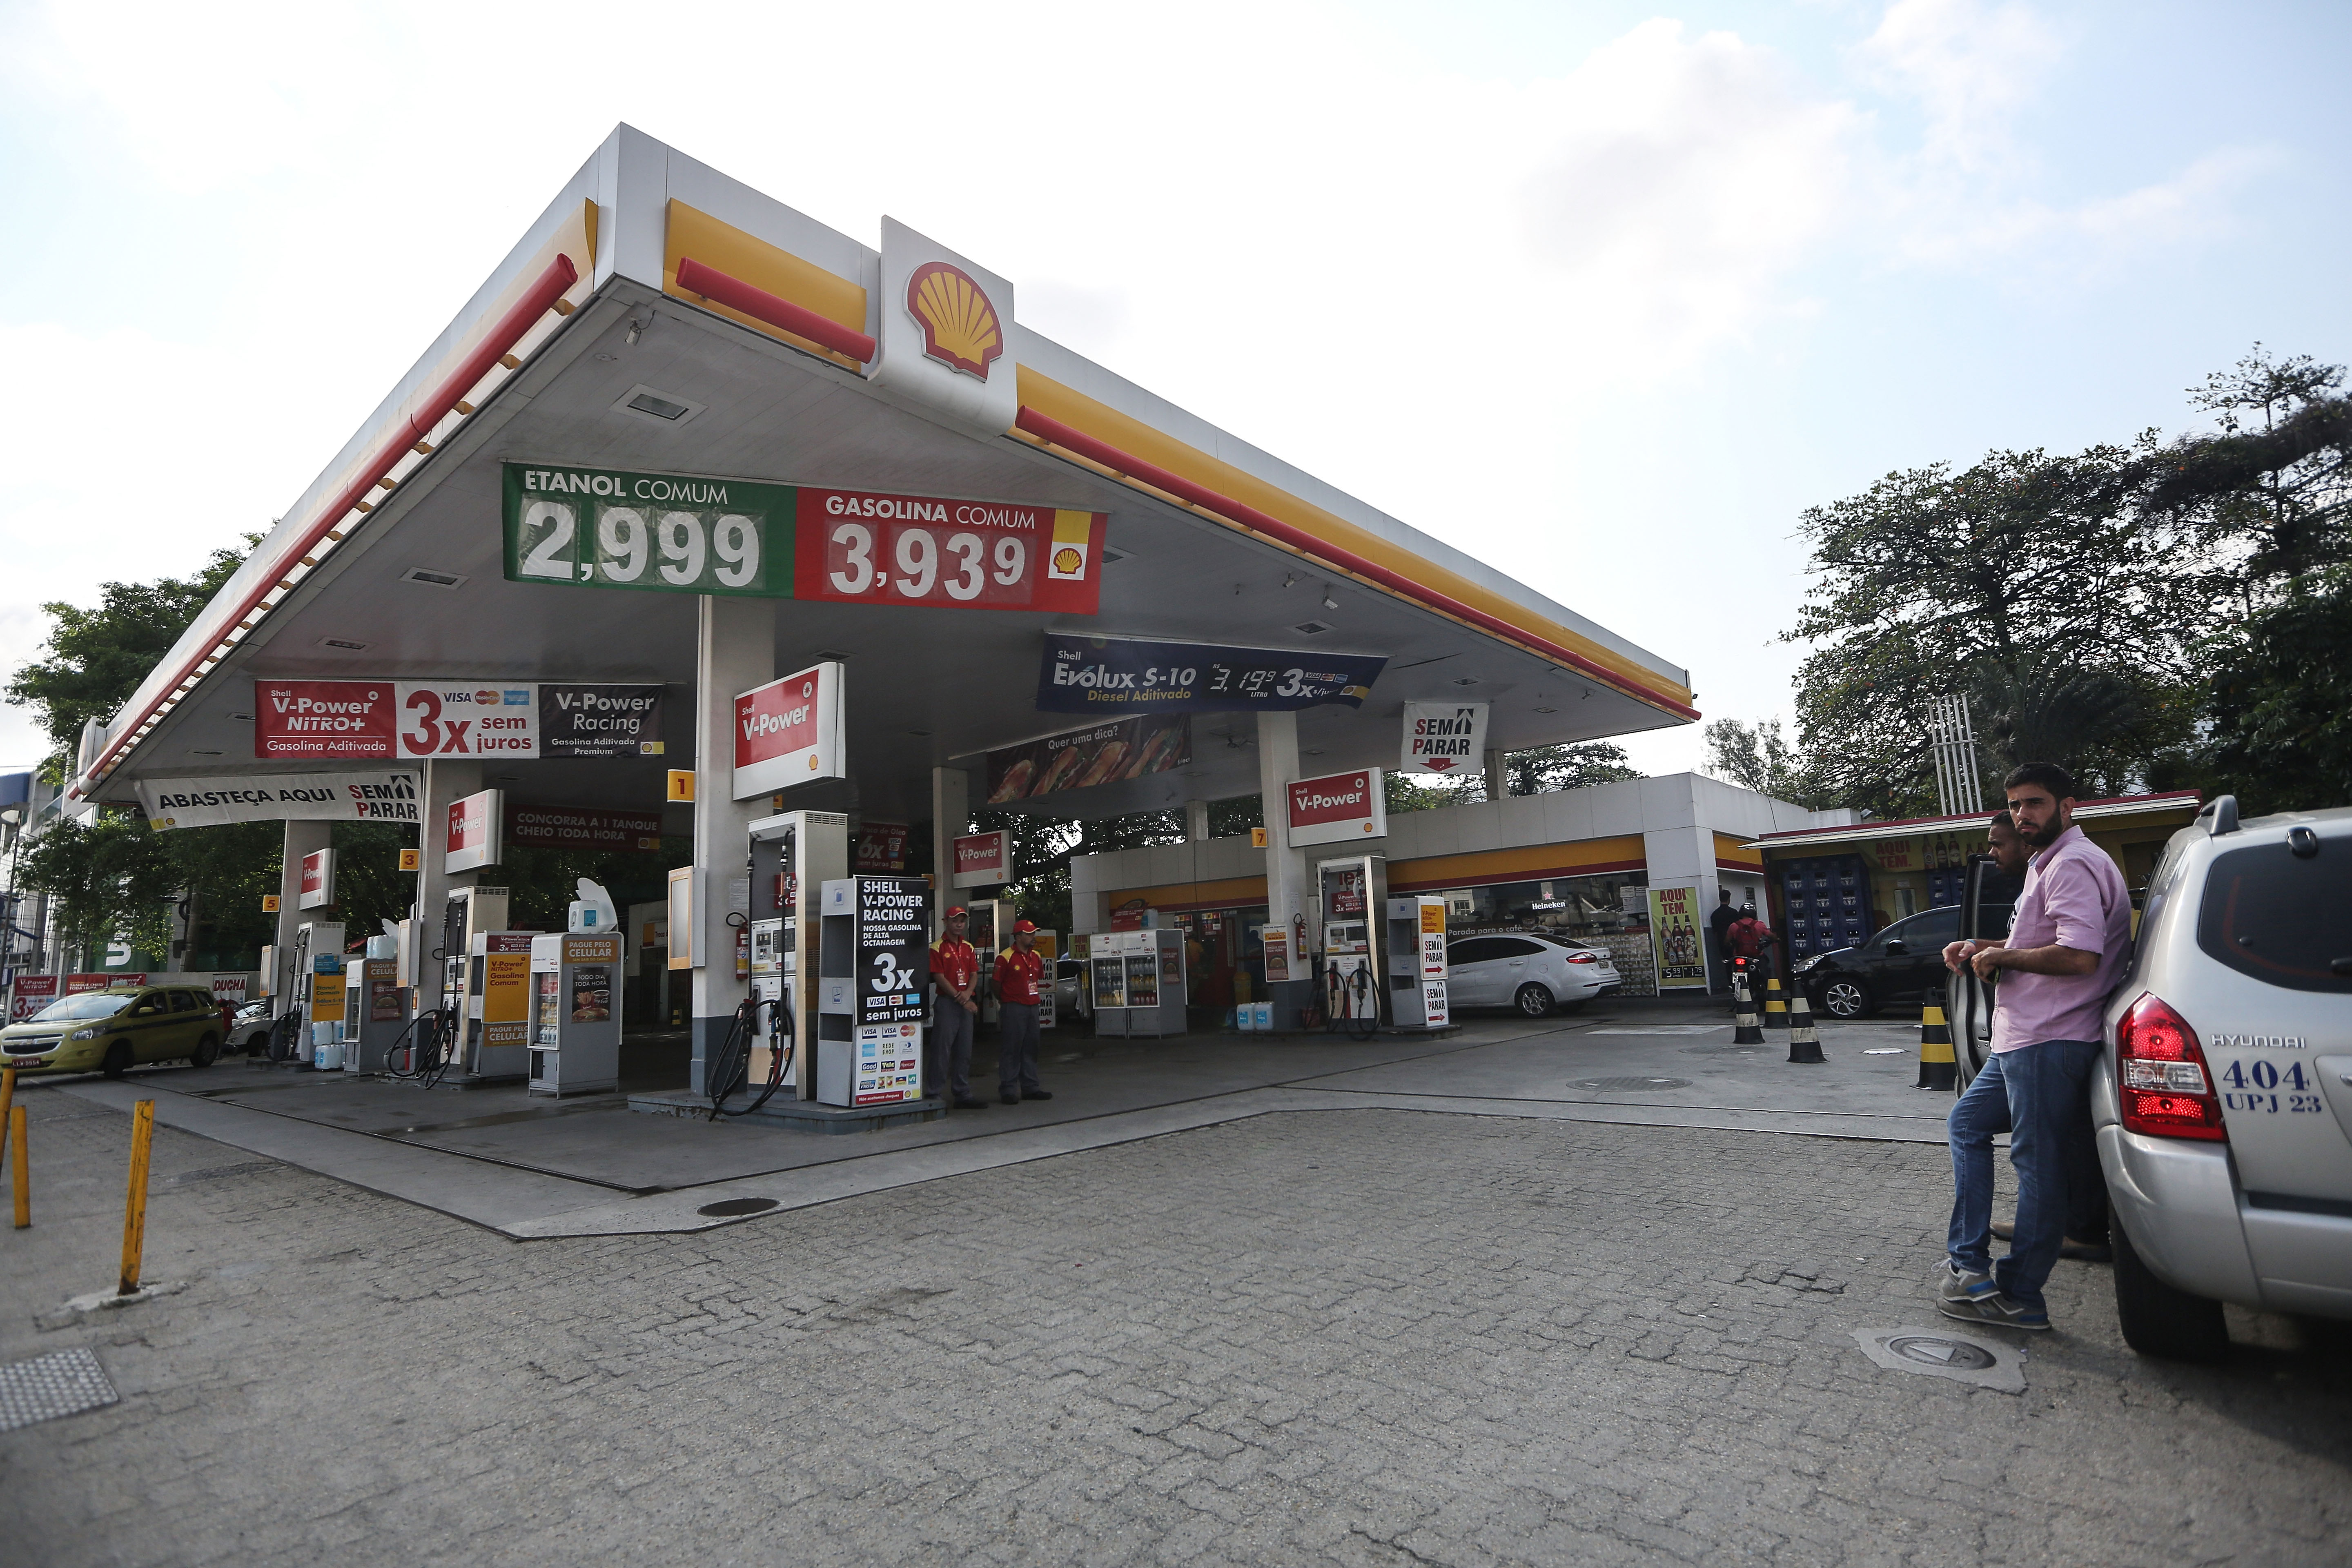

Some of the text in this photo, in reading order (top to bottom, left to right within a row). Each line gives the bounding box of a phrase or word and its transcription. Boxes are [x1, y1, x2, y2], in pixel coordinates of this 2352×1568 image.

[525, 471, 728, 504] ETANOL COMUM
[826, 496, 1035, 529] GASOLINA COMUM
[521, 501, 760, 587] 2,999
[829, 523, 1025, 600] 3,939
[1057, 650, 1081, 660] Shell
[1143, 667, 1196, 686] S-10
[1276, 668, 1314, 698] 3x
[444, 692, 471, 703] VISA
[556, 693, 654, 710] V-Power
[1087, 688, 1191, 702] Diesel Aditivado
[272, 697, 373, 714] V-Power
[742, 704, 755, 716] Shell
[402, 690, 472, 755] 3x
[481, 717, 526, 729] sem
[573, 714, 640, 734] Racing
[743, 704, 809, 740] V-Power
[1415, 718, 1454, 735] SEM
[267, 741, 386, 751] Gasolina Aditivada
[477, 733, 532, 753] juros
[1048, 726, 1118, 751] Quer uma dica?
[1412, 738, 1470, 755] PARAR
[348, 784, 393, 800] SEM
[677, 778, 685, 795] 1
[160, 788, 336, 809] ABASTEÇA AQUI
[1296, 791, 1363, 811] V-Power
[356, 802, 419, 820] PARAR
[452, 816, 482, 835] V-Power
[517, 813, 657, 831] CONCORRA A 1 TANQUE
[516, 826, 554, 837] CHEIO
[557, 828, 590, 838] TODA
[1258, 833, 1264, 844] 7
[858, 835, 884, 859] 6x
[958, 848, 998, 861] V-Power
[1875, 840, 1911, 855] AQUI
[405, 854, 414, 865] 3
[1878, 854, 1912, 868] TEM.
[863, 881, 902, 893] SHELL
[863, 895, 923, 907] V-POWER
[1660, 889, 1686, 902] AQUI
[267, 900, 275, 908] 5
[1532, 901, 1566, 910] Heineken
[1662, 902, 1688, 915] TEM.
[863, 909, 914, 921] RACING
[1448, 928, 1475, 936] Parada
[569, 948, 612, 957] CELULAR
[1425, 940, 1437, 951] SEM
[1425, 952, 1443, 962] PARAR
[871, 953, 914, 992] 3x
[214, 979, 245, 991] DUCHA
[869, 997, 885, 1005] VISA
[1427, 988, 1439, 999] SEM
[13, 997, 36, 1018] 3x
[1428, 1000, 1445, 1011] PARAR
[866, 1007, 922, 1021] sem juros
[2210, 1034, 2306, 1049] HYUNDAI
[2223, 1060, 2310, 1091] 404
[2225, 1093, 2322, 1114] UPJ 23
